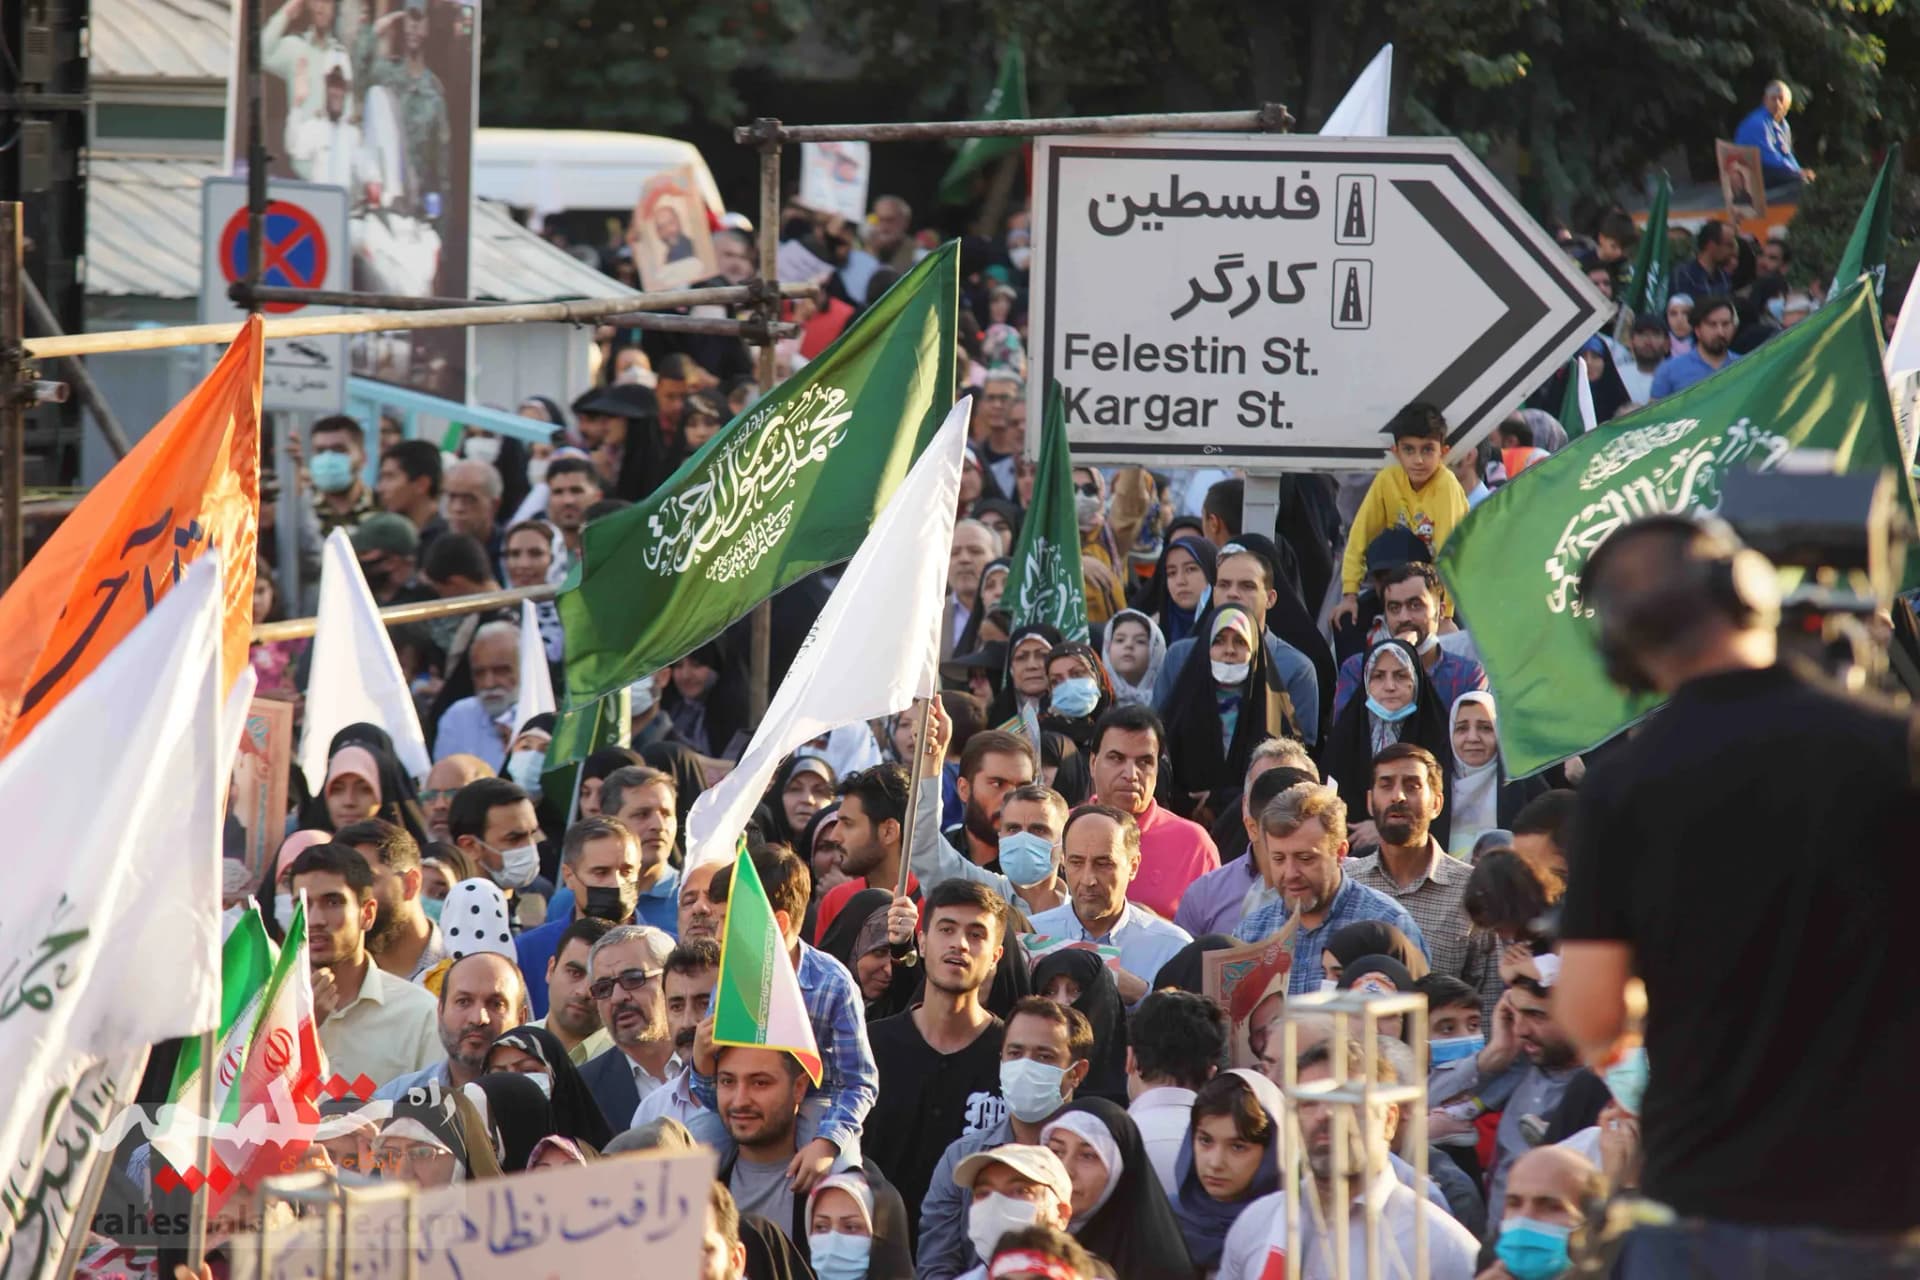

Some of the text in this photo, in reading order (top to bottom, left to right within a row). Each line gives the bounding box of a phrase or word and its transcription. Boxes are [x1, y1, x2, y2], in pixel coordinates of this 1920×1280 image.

[1089, 170, 1320, 237] فلسطین
[1169, 253, 1318, 321] کارگر
[1063, 333, 1319, 377] Felestin St.
[1064, 386, 1294, 431] Kargar St.
